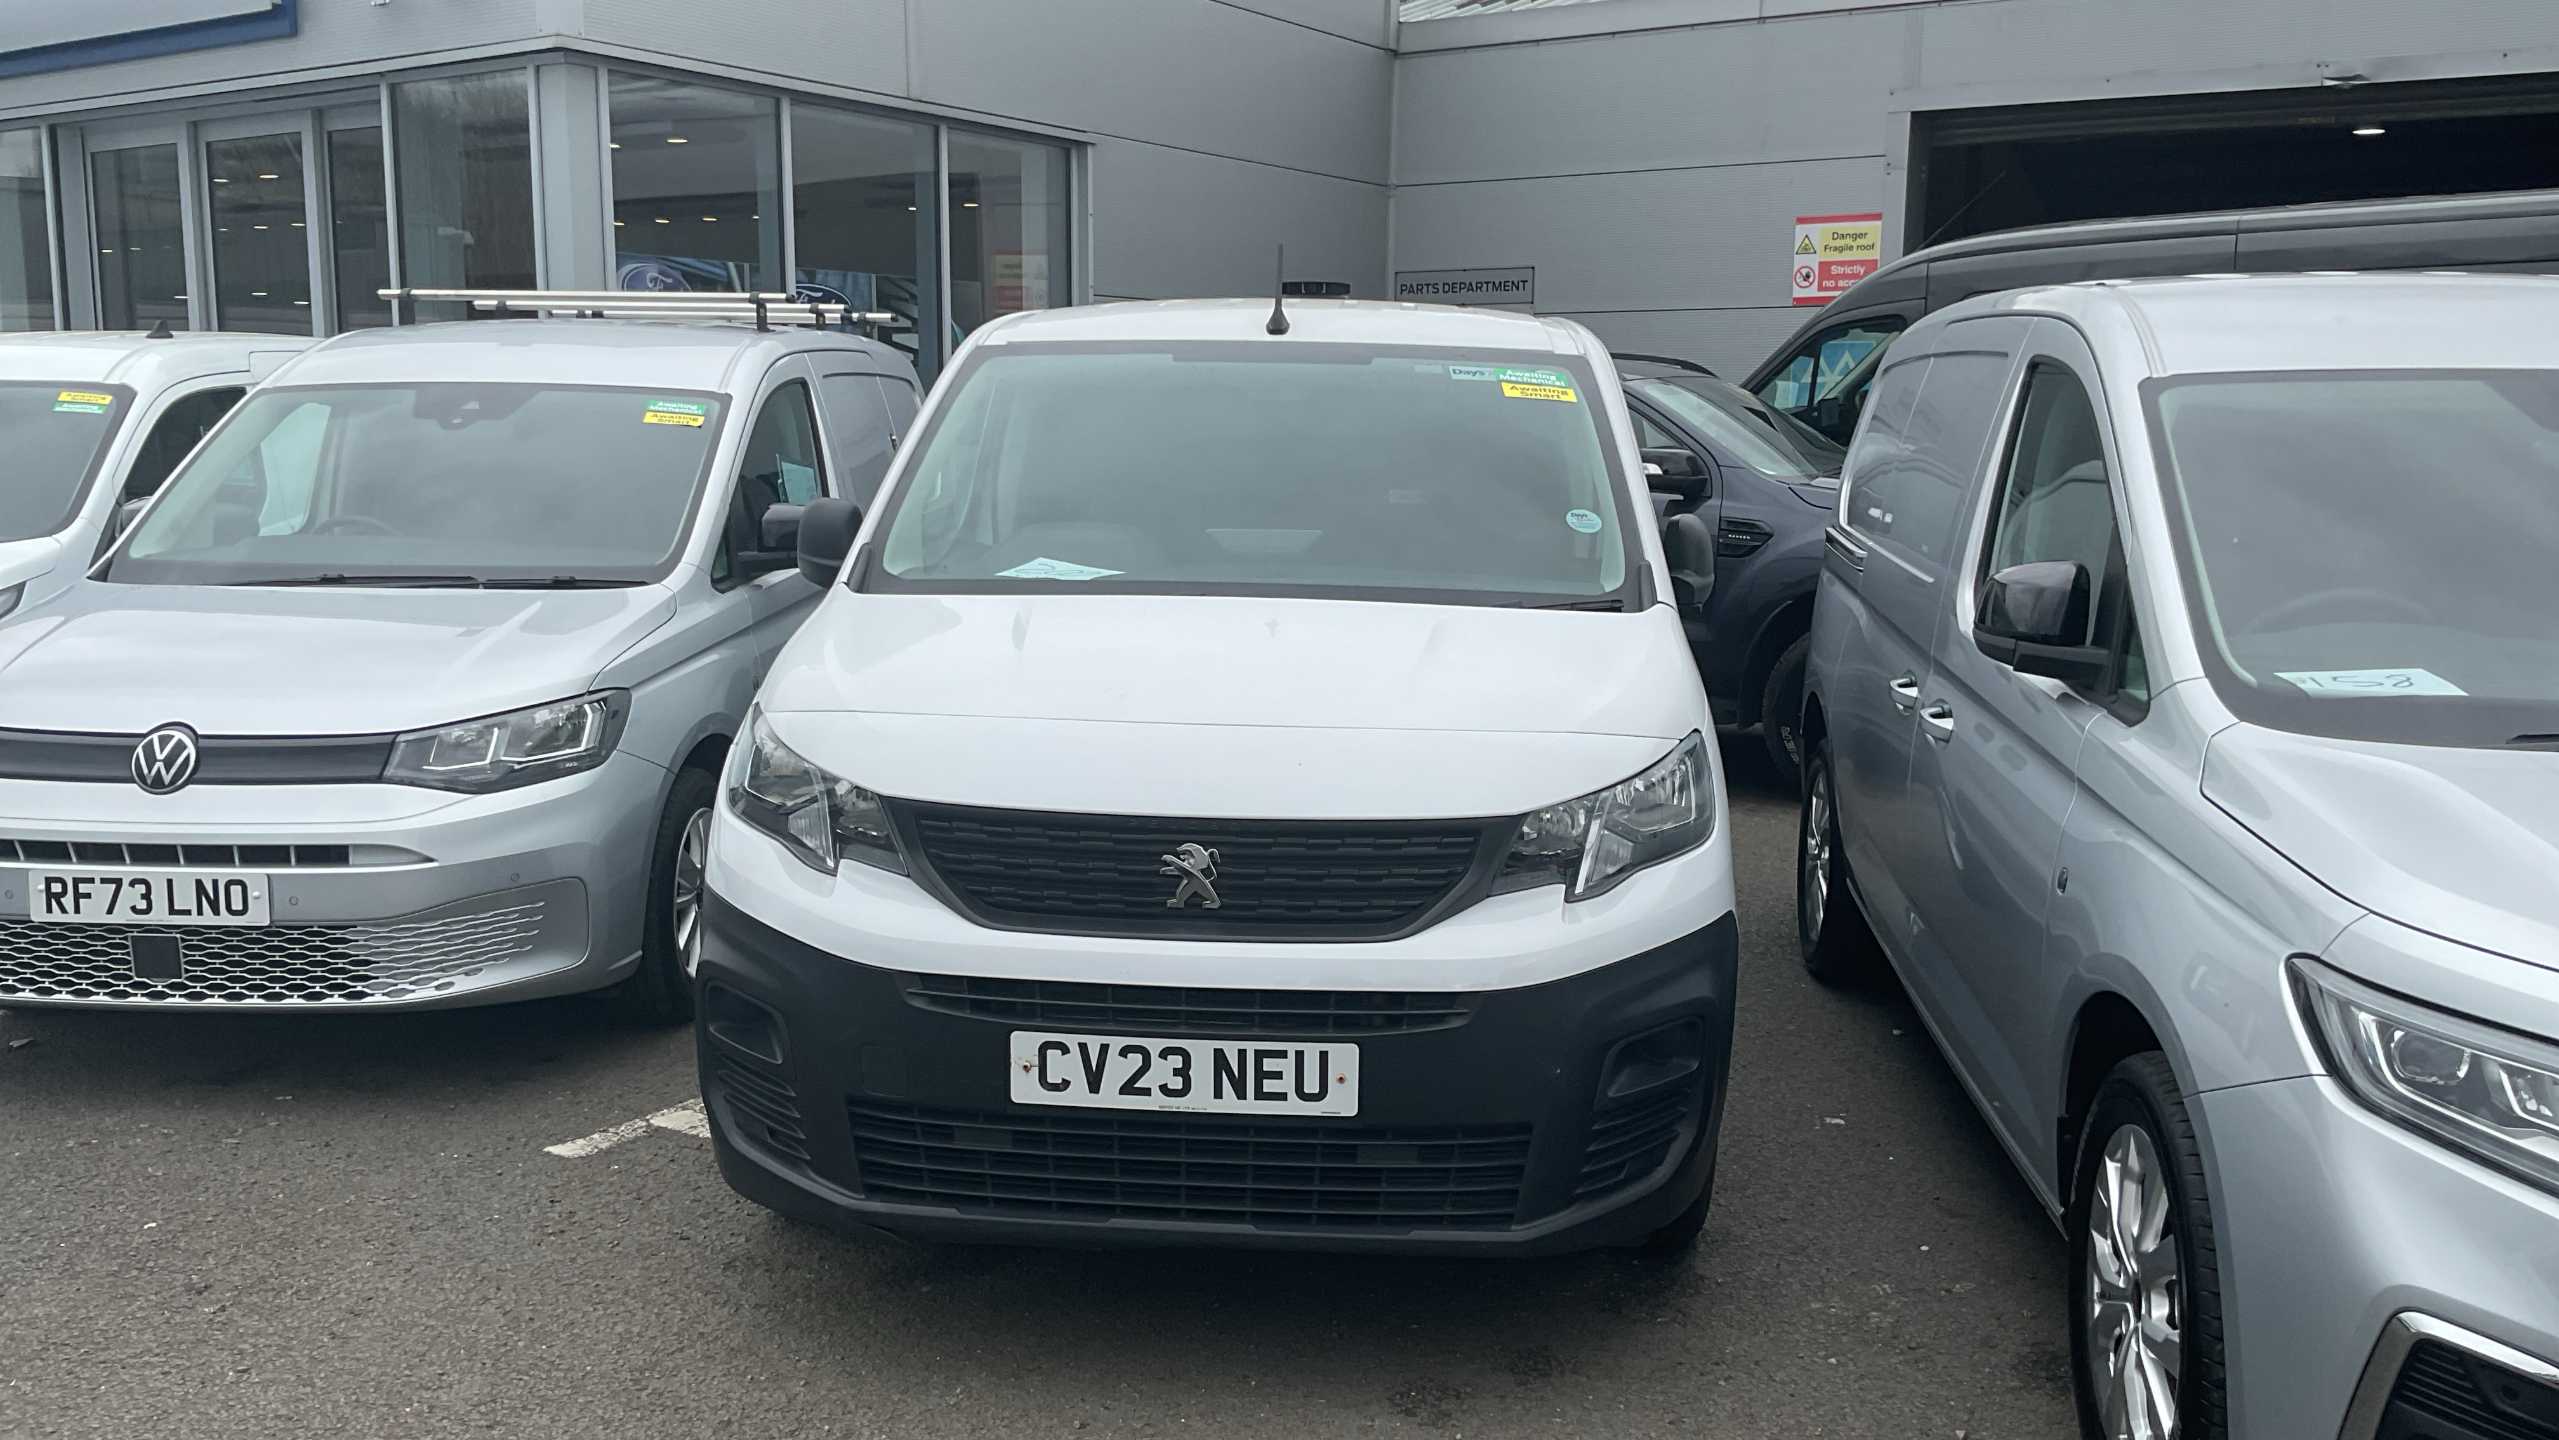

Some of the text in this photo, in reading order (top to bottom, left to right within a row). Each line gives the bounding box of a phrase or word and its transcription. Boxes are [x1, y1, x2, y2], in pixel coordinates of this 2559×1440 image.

[1831, 231, 1868, 242] Danger
[1824, 243, 1875, 253] Fragile roof
[1831, 264, 1866, 275] Strictly
[1400, 280, 1529, 295] PARTS DEPARTMENT
[1822, 279, 1856, 288] no acc
[1509, 385, 1569, 396] Awaiting
[45, 876, 249, 917] RF73 LNO
[1038, 1040, 1329, 1102] CV23 NEU
